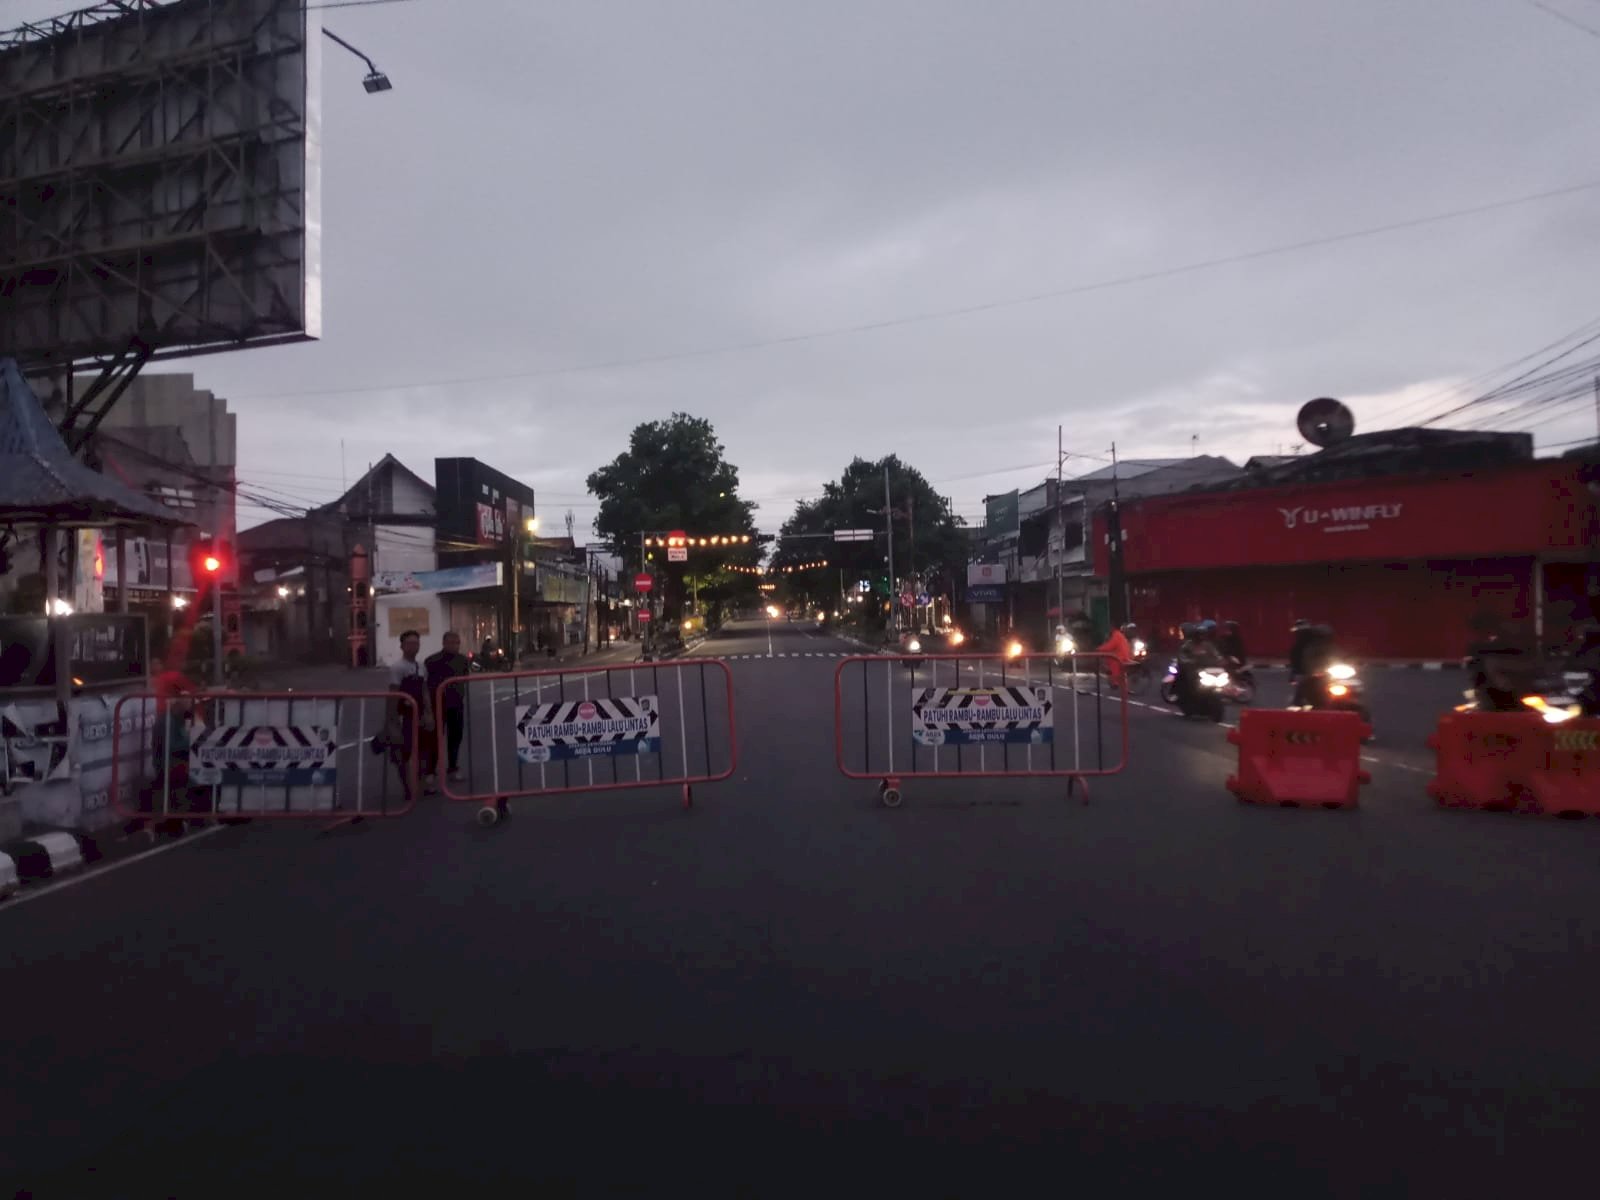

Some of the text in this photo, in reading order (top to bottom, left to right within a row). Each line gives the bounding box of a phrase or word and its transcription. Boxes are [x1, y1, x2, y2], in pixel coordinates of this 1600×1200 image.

[923, 707, 1042, 722] PATUHI RAMBU-RAMBU LALU LINTAS
[528, 717, 648, 739] PATUHI RAMBU-RAMBU LALU LINTAS
